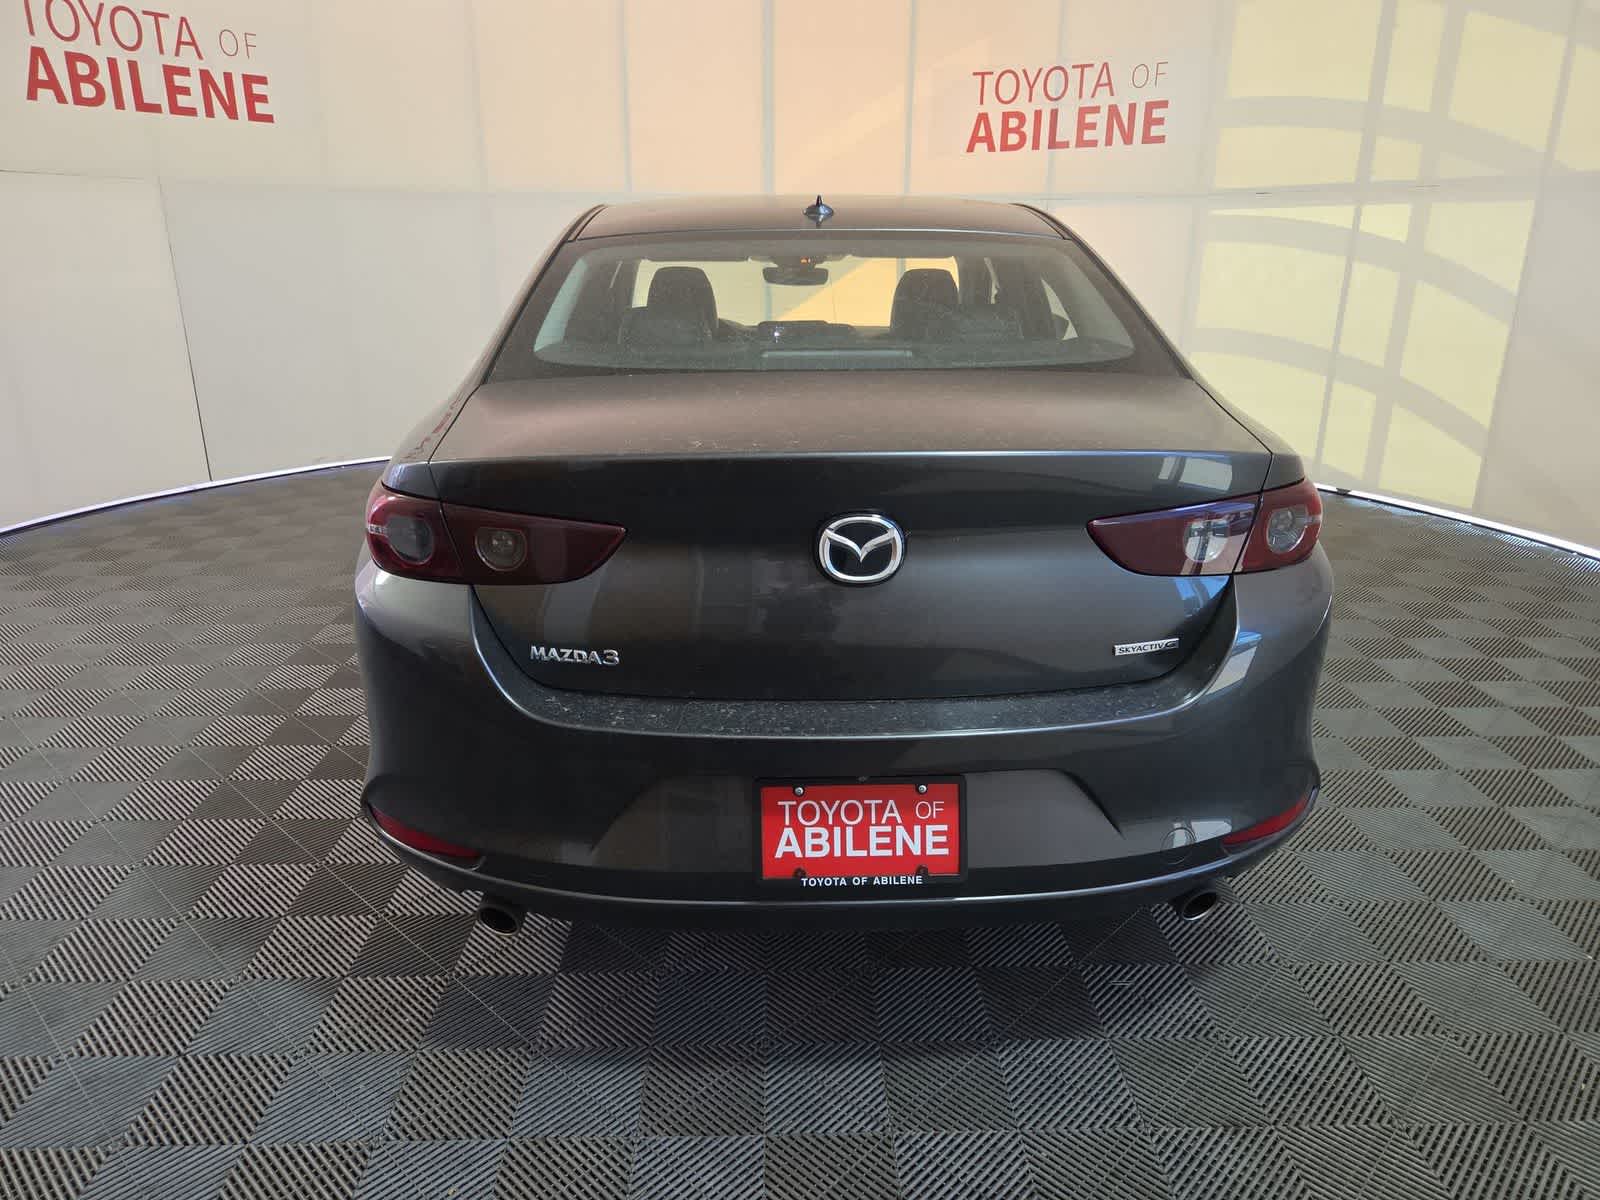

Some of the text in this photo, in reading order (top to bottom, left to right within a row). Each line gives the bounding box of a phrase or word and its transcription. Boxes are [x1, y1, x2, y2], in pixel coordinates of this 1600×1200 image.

[218, 29, 257, 59] OF
[26, 46, 275, 123] ABILENE
[972, 61, 1169, 105] TOYOTA OF
[966, 100, 1169, 152] ABILENE
[777, 799, 944, 826] TOYOTA OF
[774, 824, 949, 858] ABILENE
[801, 876, 923, 887] TOYOTA OF ABILENE
